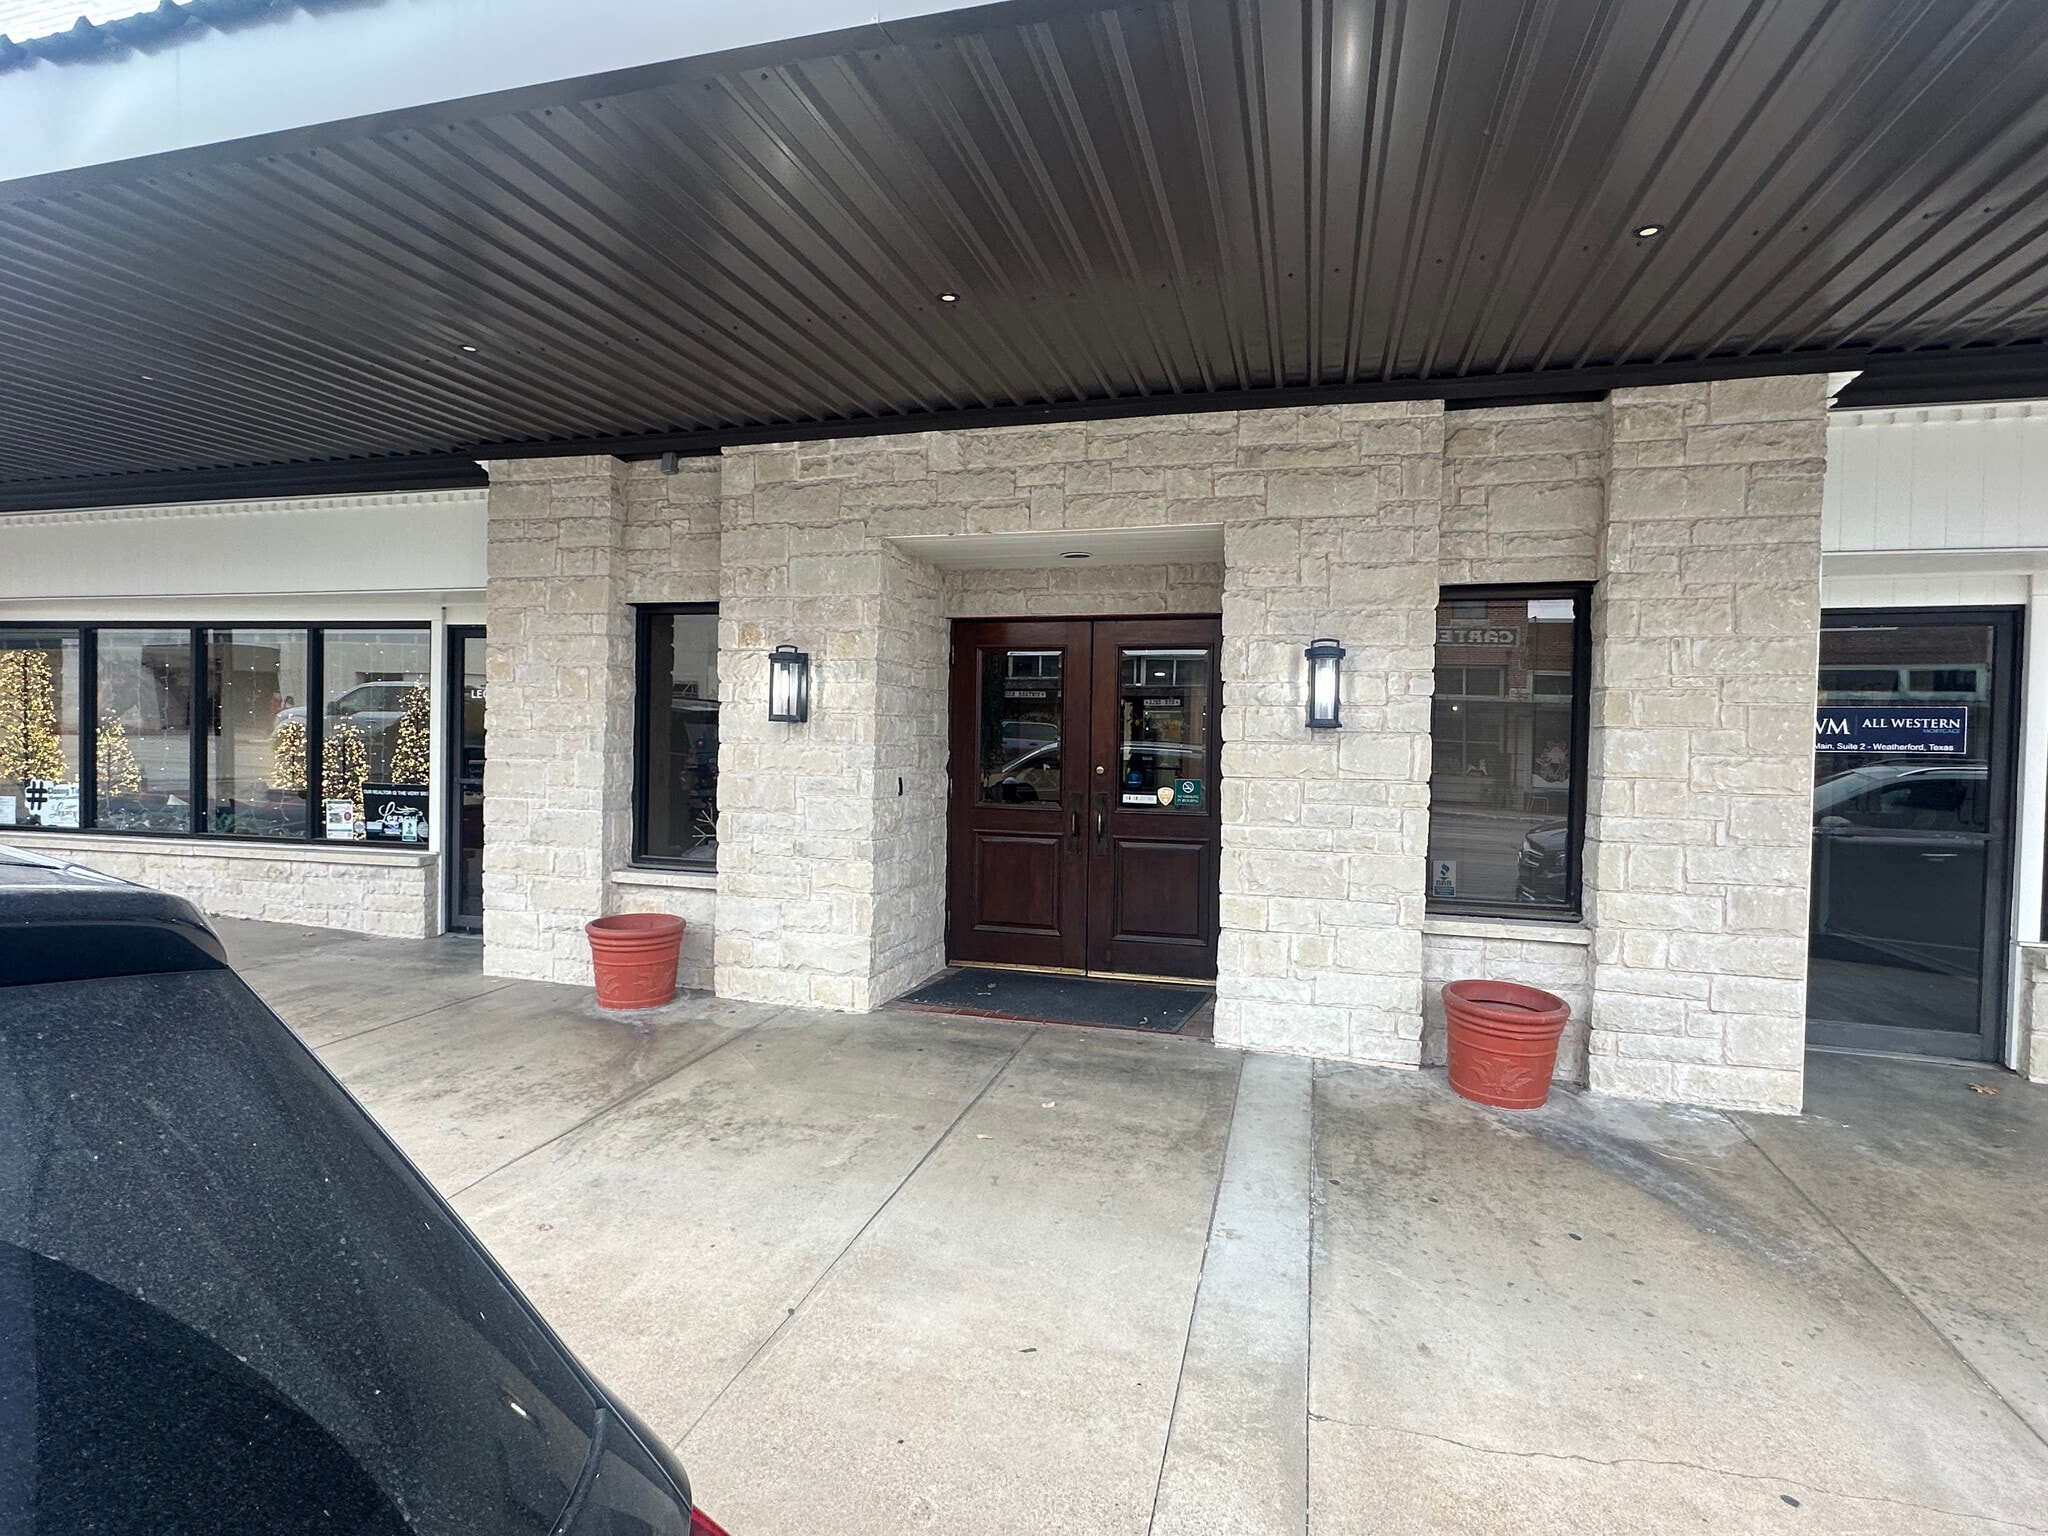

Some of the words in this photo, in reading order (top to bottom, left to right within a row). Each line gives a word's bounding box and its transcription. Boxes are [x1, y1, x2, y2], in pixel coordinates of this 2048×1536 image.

[1862, 718, 1888, 728] ALL
[1890, 718, 1960, 729] WESTERN
[1836, 742, 1858, 750] Suite
[1859, 742, 1866, 750] 2
[1928, 743, 1954, 751] Texas
